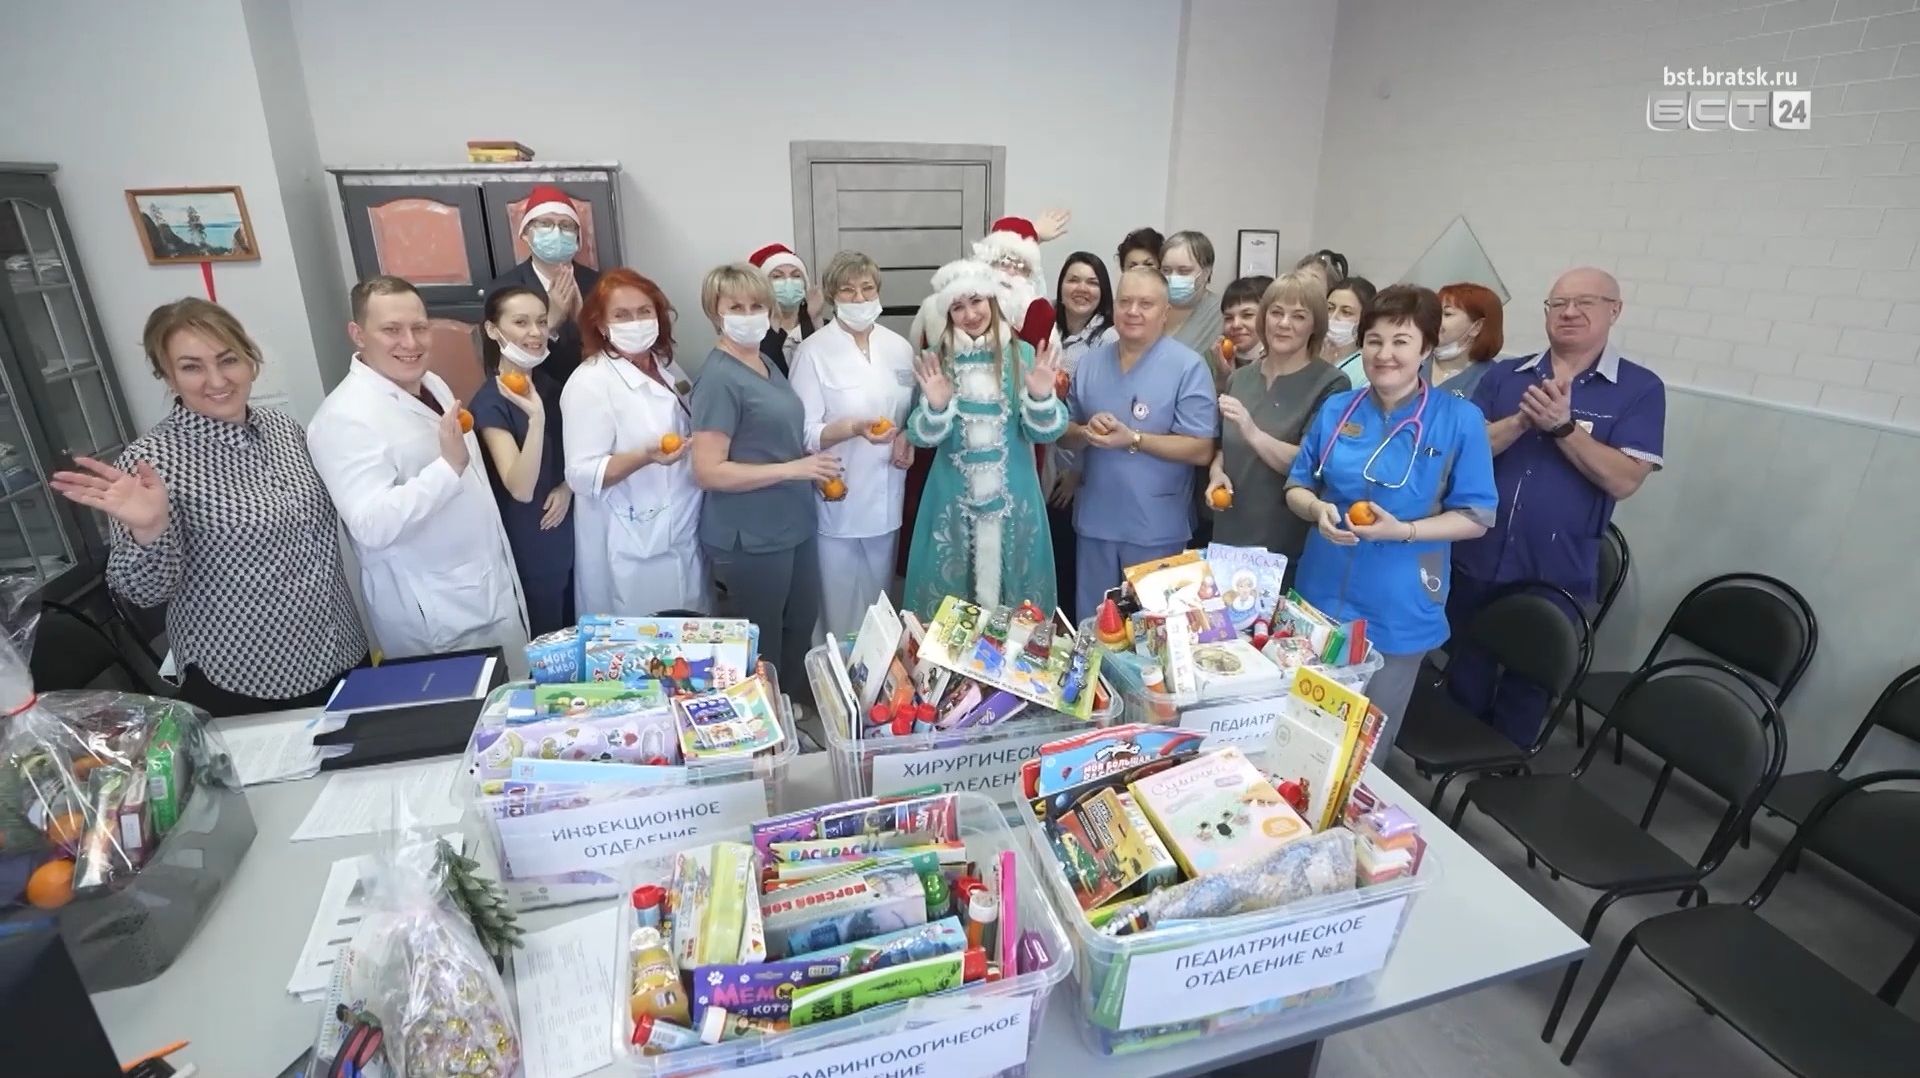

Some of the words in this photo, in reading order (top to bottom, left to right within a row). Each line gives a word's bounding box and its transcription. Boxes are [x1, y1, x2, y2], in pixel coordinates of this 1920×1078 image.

[1210, 712, 1276, 733] ПЕДИАТР
[903, 745, 1041, 778] ХИРУРГИЧЕСК
[942, 771, 1022, 793] ТДЕЛЕН
[552, 800, 721, 842] ИНФЕКЦИОННОЕ
[1176, 915, 1366, 971] ПЕДИАТРИЧЕСКОЕ
[1185, 950, 1306, 989] ОТДЕЛЕНИЕ
[786, 1013, 1021, 1078] АРИНГОЛОГИЧЕСКОЕ
